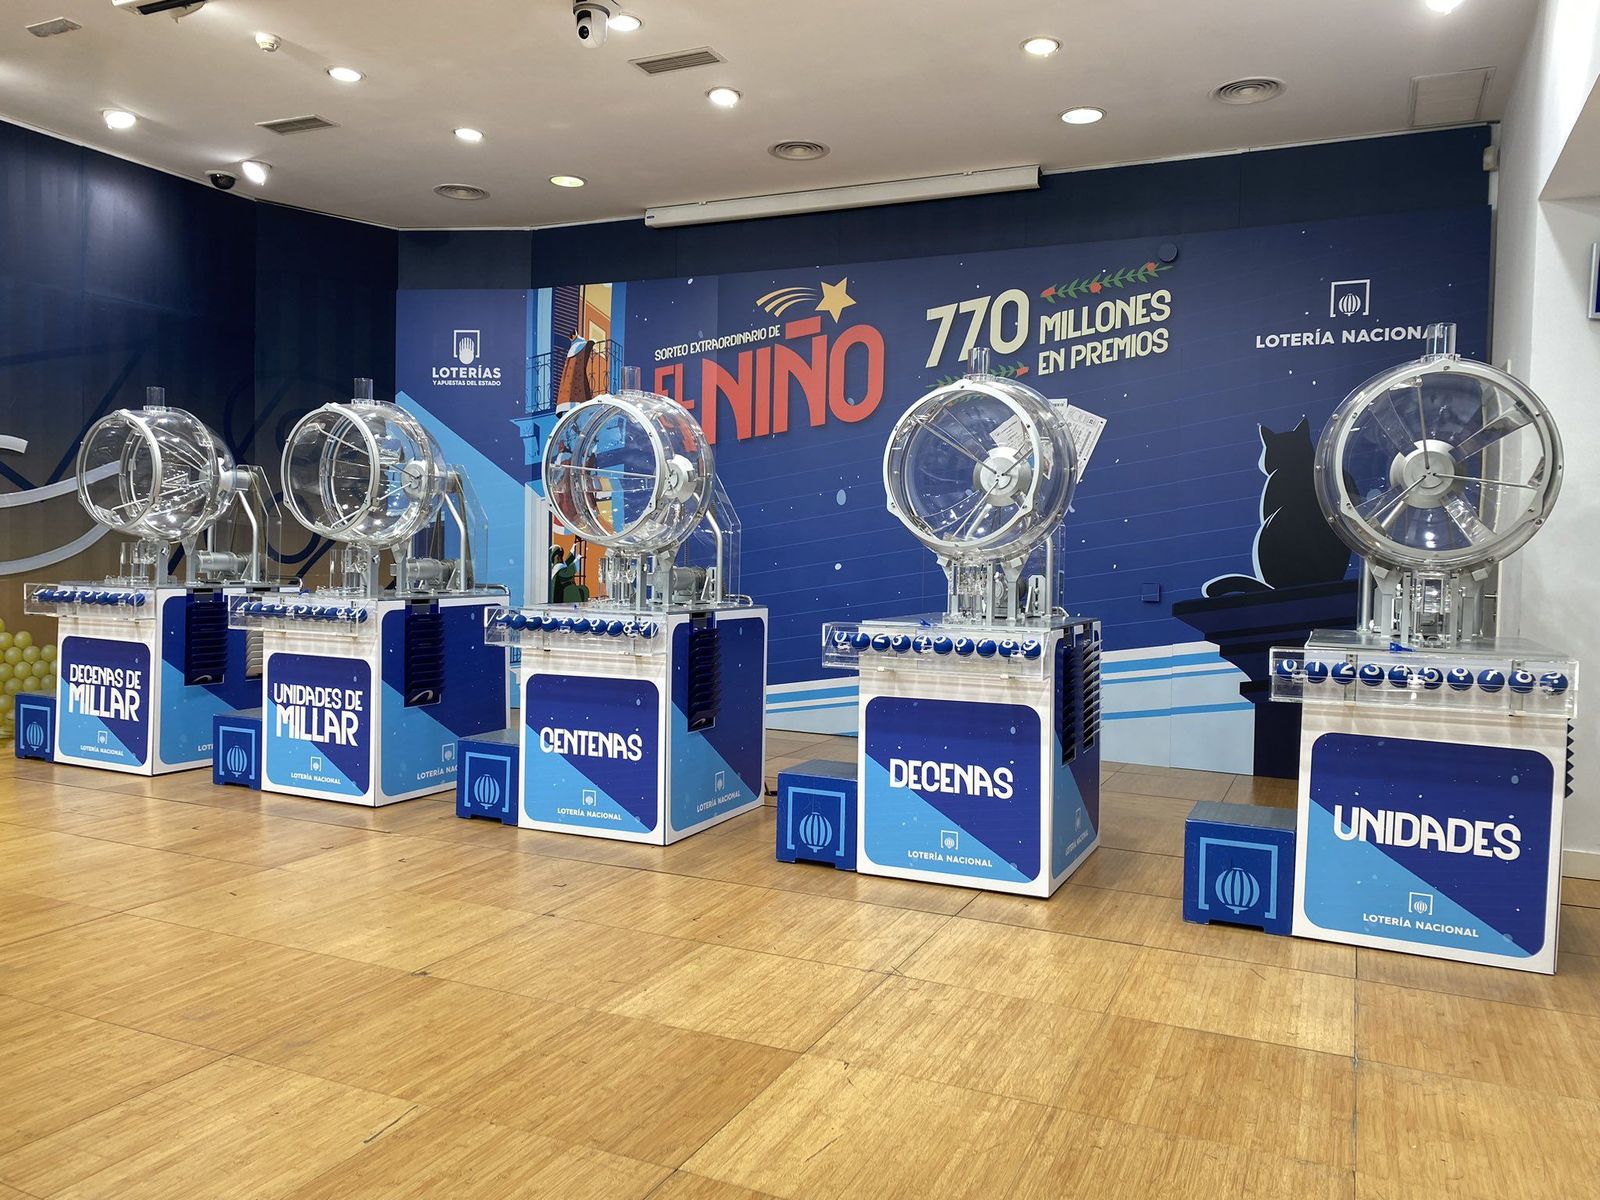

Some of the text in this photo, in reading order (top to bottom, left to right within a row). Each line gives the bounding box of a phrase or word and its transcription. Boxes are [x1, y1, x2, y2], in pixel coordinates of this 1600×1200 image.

[925, 288, 1030, 368] 770
[1039, 289, 1172, 345] MILLONES
[654, 324, 781, 361] SORTEO EXTRAORDINARIO DE
[1038, 328, 1169, 376] EN PREMIOS
[1256, 329, 1335, 349] LOTERÍA
[432, 365, 501, 379] LOTERÍAS
[701, 316, 885, 446] NIÑO
[69, 663, 142, 690] DECENAS DE
[1423, 667, 1439, 682] 5
[68, 682, 141, 722] MILLAR
[273, 682, 363, 711] UNIDADES DE
[276, 703, 359, 747] MILLAR
[540, 726, 642, 761] CENTENAS
[416, 767, 444, 780] LOTERÍA
[889, 758, 1014, 799] DECENAS
[557, 807, 622, 820] LOTERÍA NACIONAL
[1333, 804, 1522, 861] UNIDADES
[907, 849, 993, 867] LOTERÍA NACIONAL
[1362, 913, 1479, 938] LOTERÍA NACIONAL
